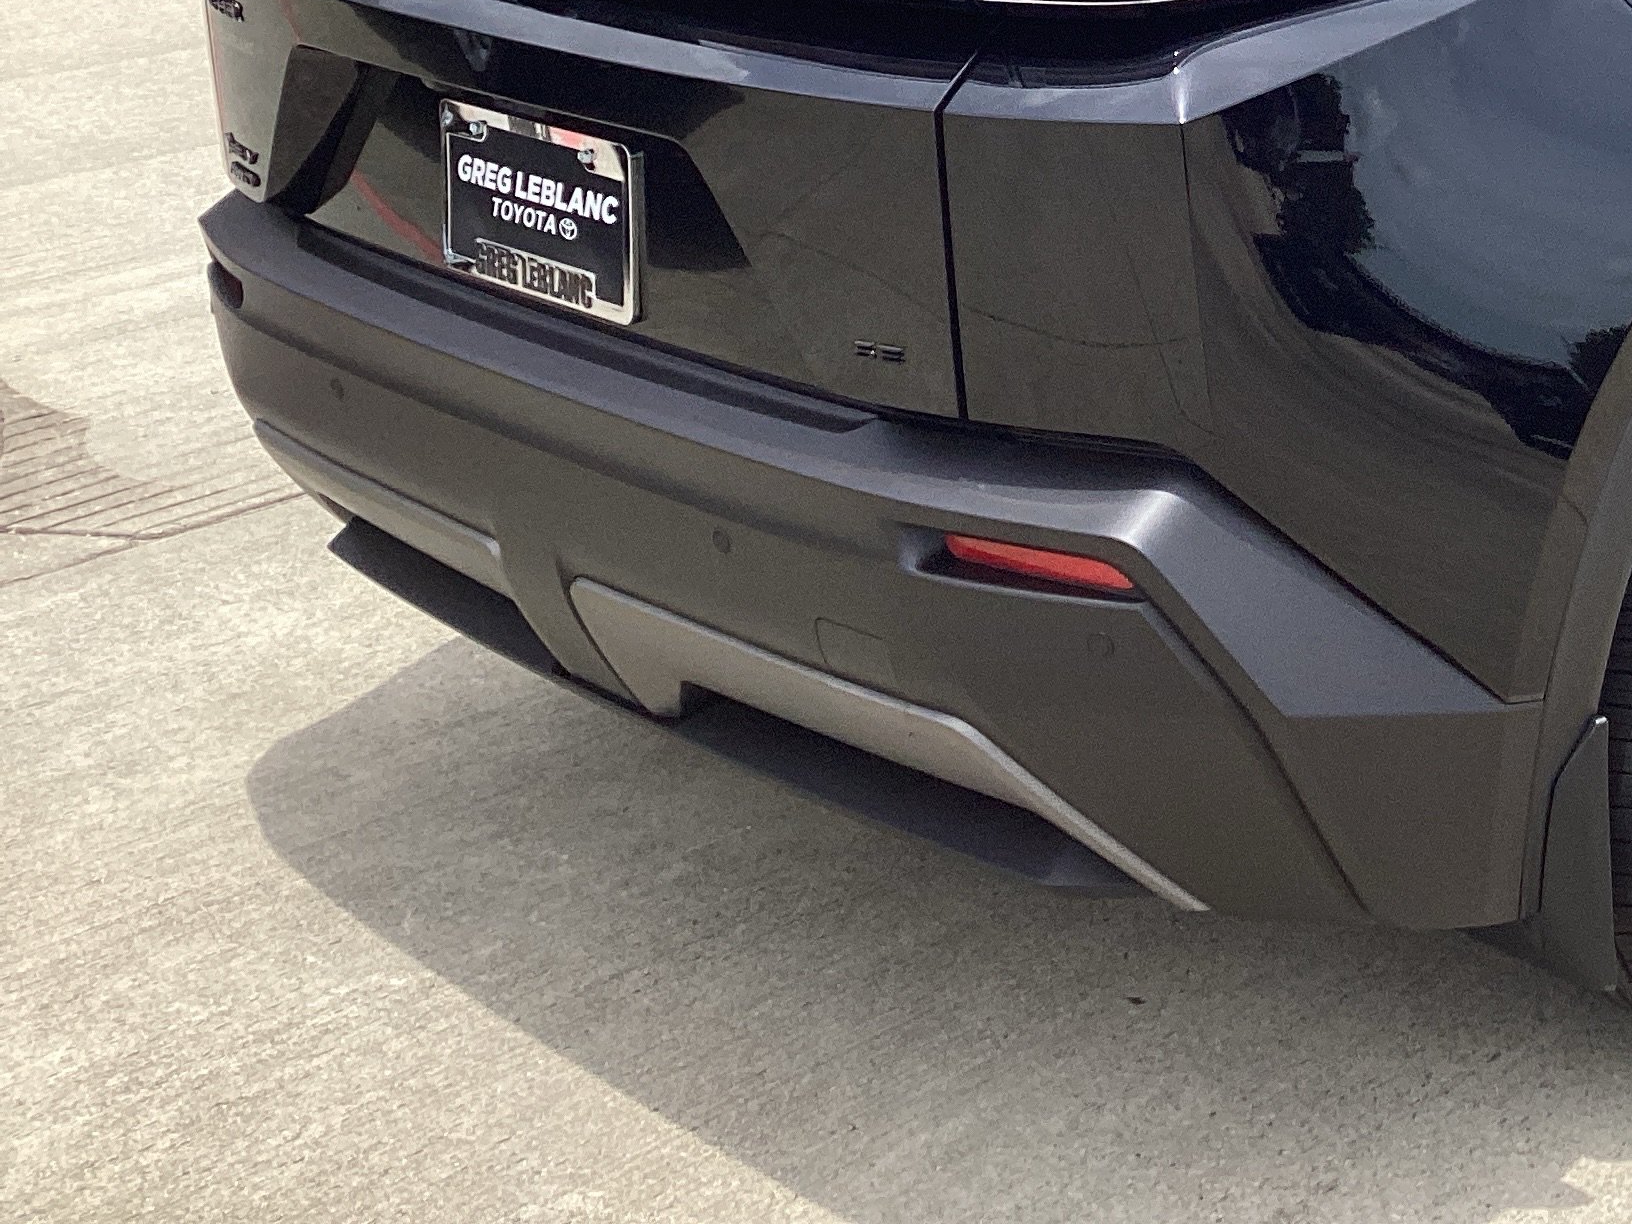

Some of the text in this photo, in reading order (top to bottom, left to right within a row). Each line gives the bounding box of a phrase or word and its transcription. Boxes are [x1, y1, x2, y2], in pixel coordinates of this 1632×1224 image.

[457, 153, 619, 225] GREG LEBLANC
[492, 196, 557, 235] TOYOTA
[474, 243, 593, 309] GREG LEBLANC
